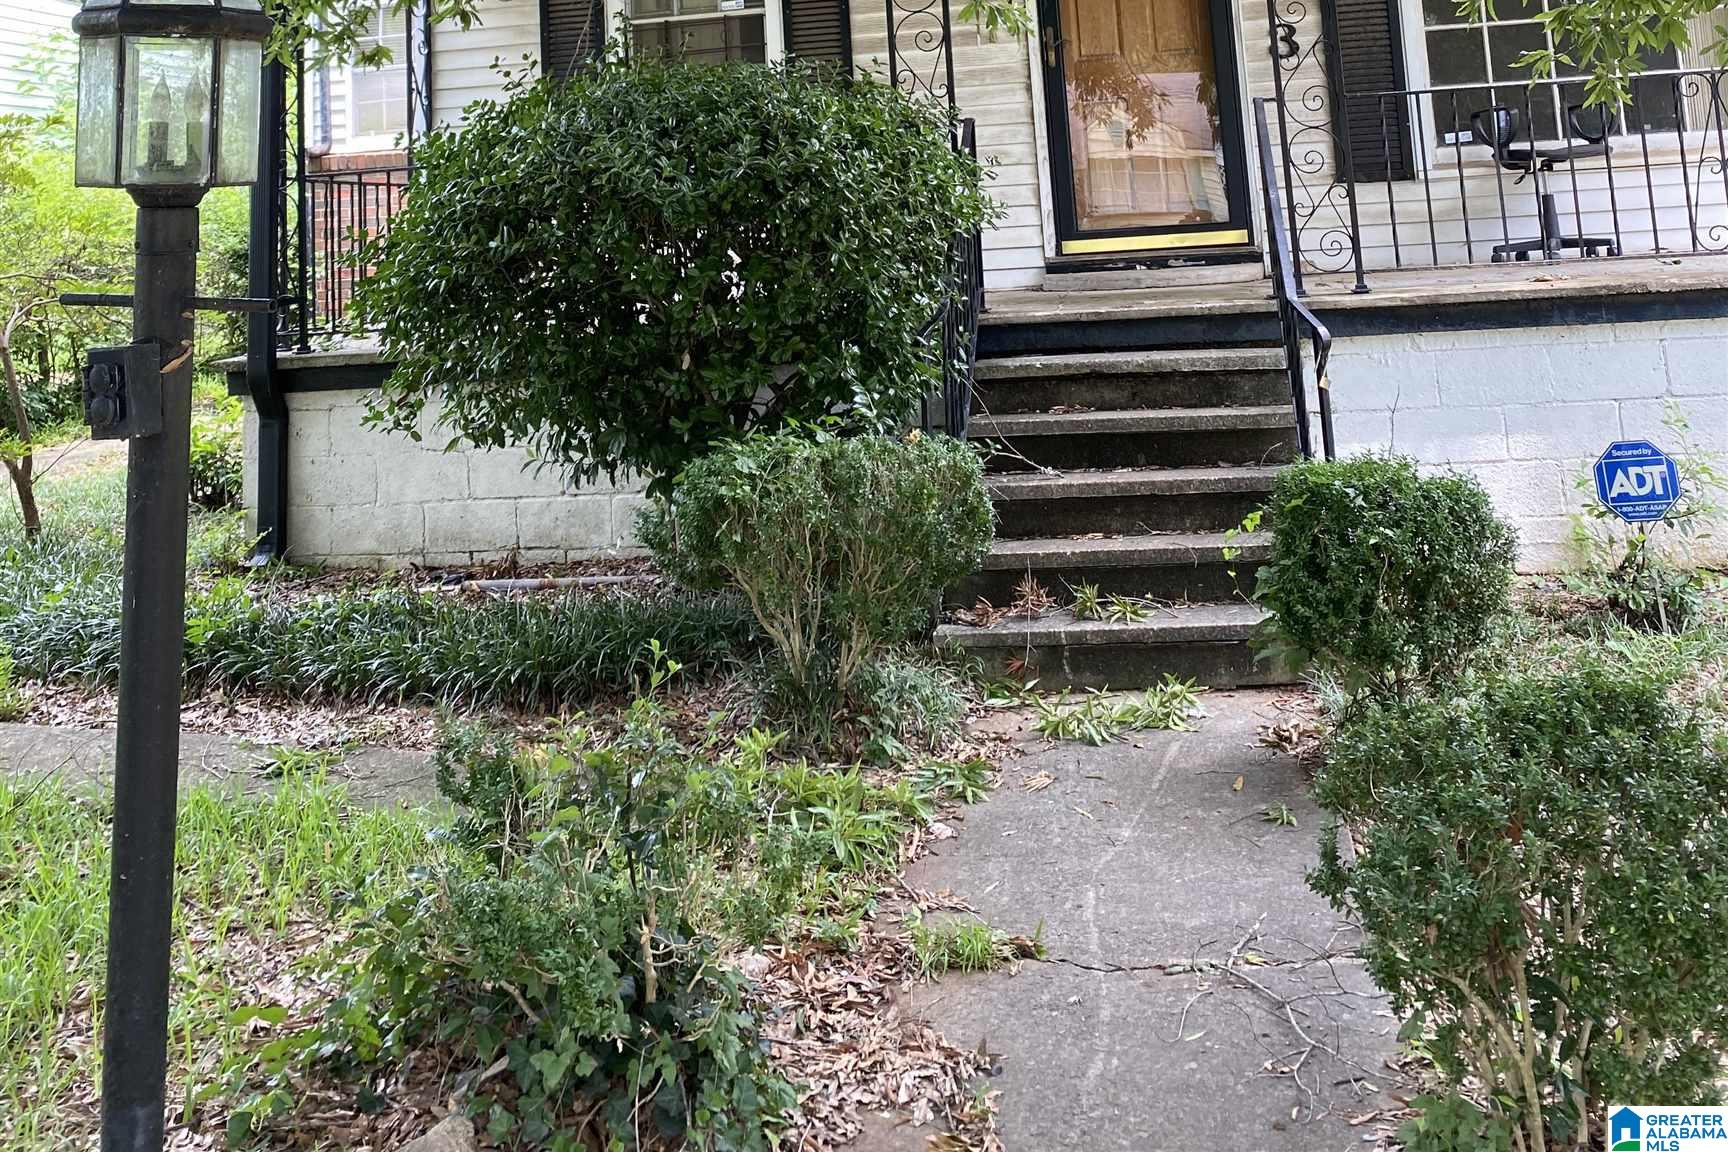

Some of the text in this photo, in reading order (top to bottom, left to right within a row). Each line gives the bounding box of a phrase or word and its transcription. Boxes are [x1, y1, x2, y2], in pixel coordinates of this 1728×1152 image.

[1611, 447, 1652, 457] Secured by
[1610, 465, 1666, 498] ADT
